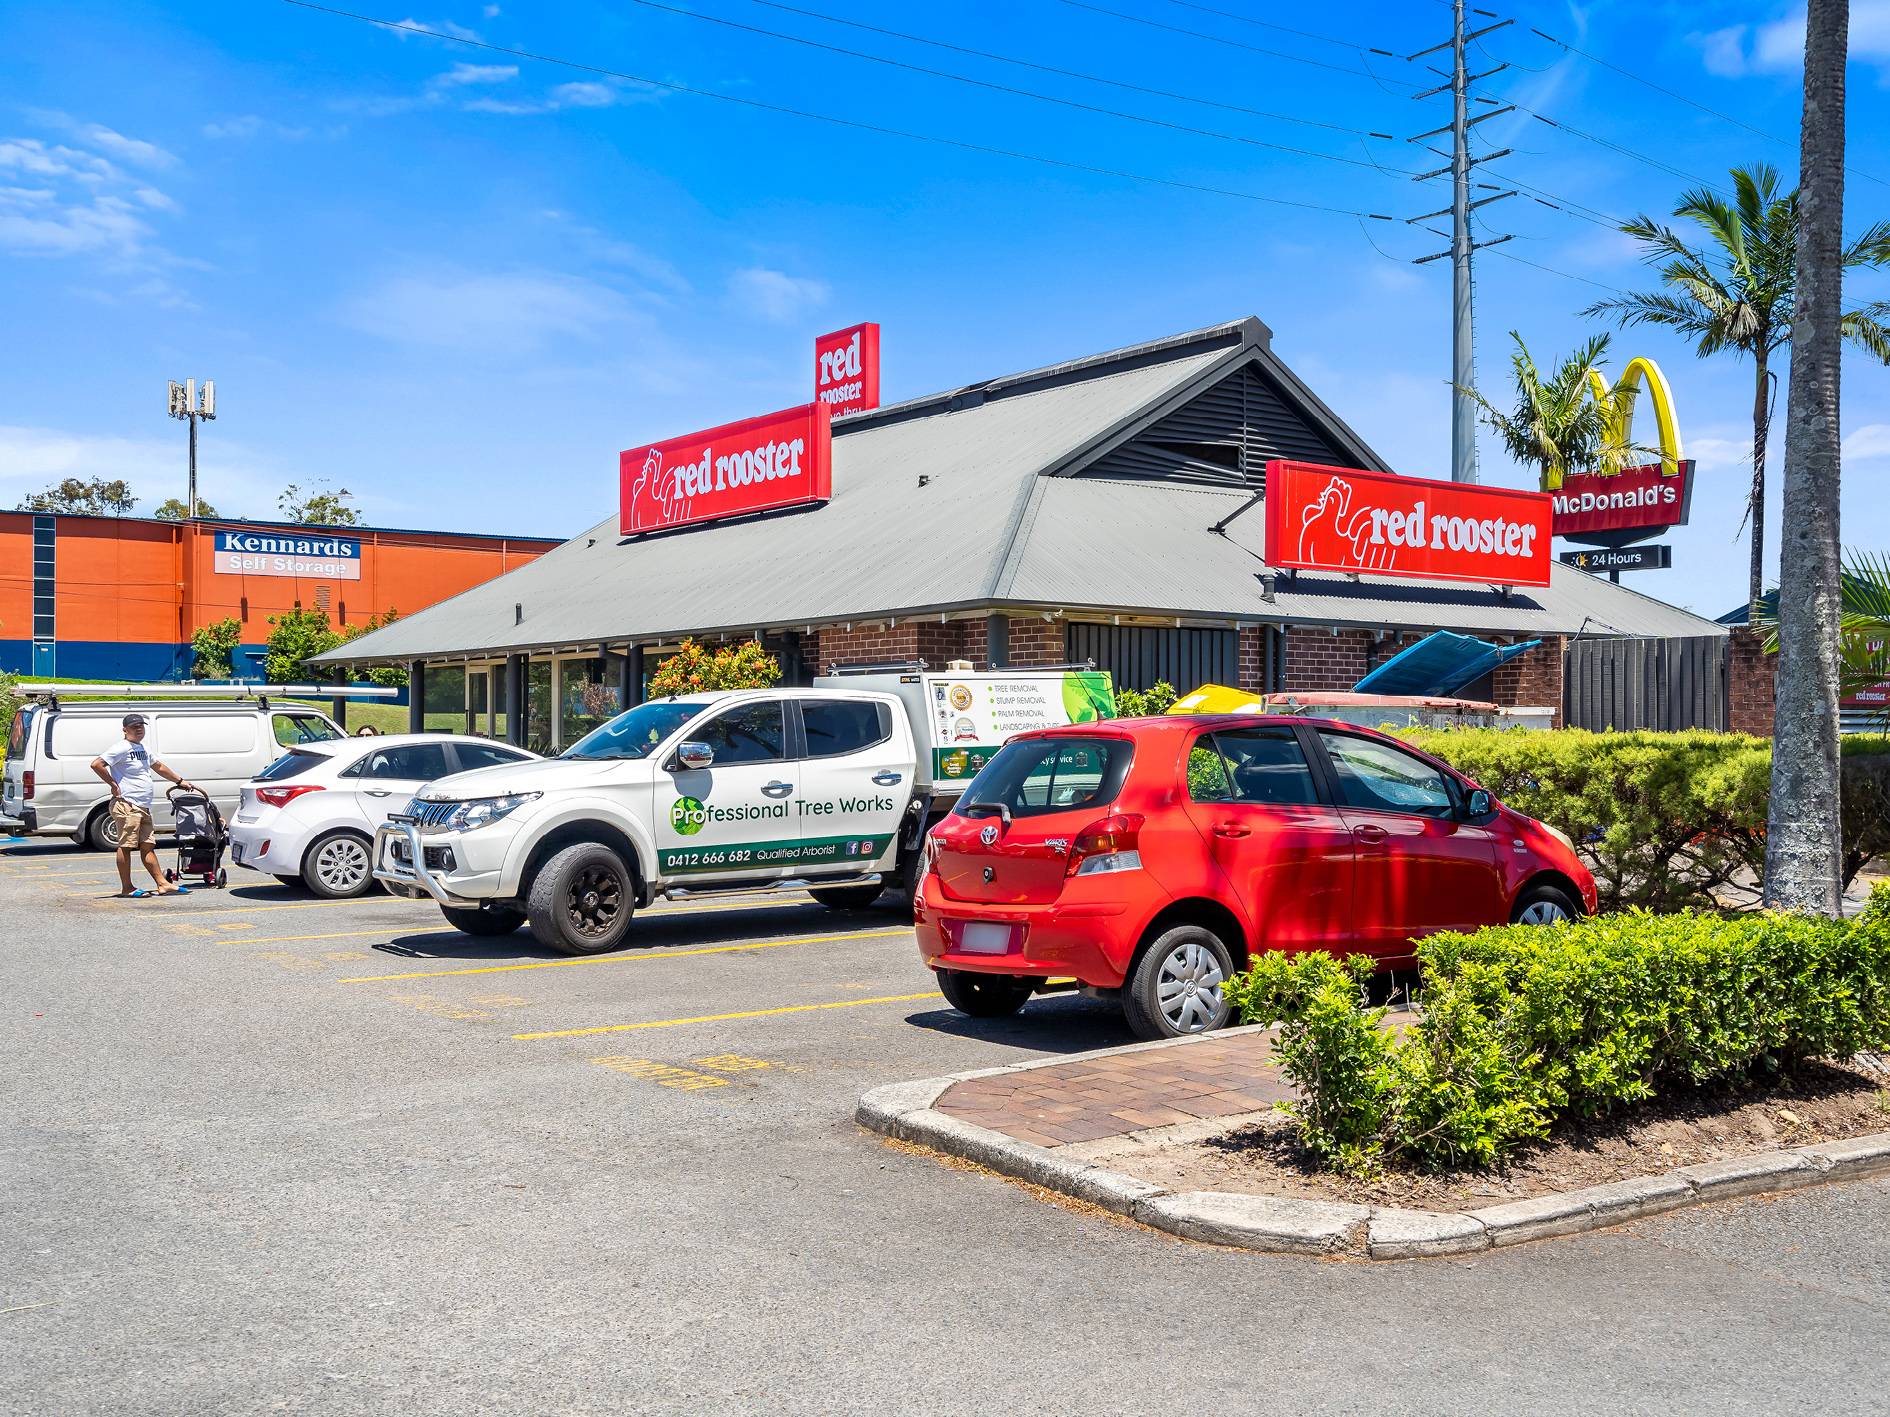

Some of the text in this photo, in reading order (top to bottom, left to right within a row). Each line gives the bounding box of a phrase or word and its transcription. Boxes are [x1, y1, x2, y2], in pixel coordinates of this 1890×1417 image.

[820, 331, 862, 385] red
[820, 381, 862, 404] rooster
[674, 438, 804, 499] red rooster
[1553, 485, 1676, 514] McDonald's
[1370, 501, 1536, 558] red rooster
[224, 533, 352, 556] Kennards
[230, 555, 346, 575] Self Storage
[1592, 553, 1642, 565] 24 Hours
[1000, 722, 1040, 731] LANDSCAPING
[673, 795, 893, 825] Professional Tree Works
[667, 854, 698, 867] 0412
[702, 852, 724, 864] 666
[728, 850, 751, 862] 682
[757, 848, 801, 860] Qualified
[802, 845, 835, 856] Arborist
